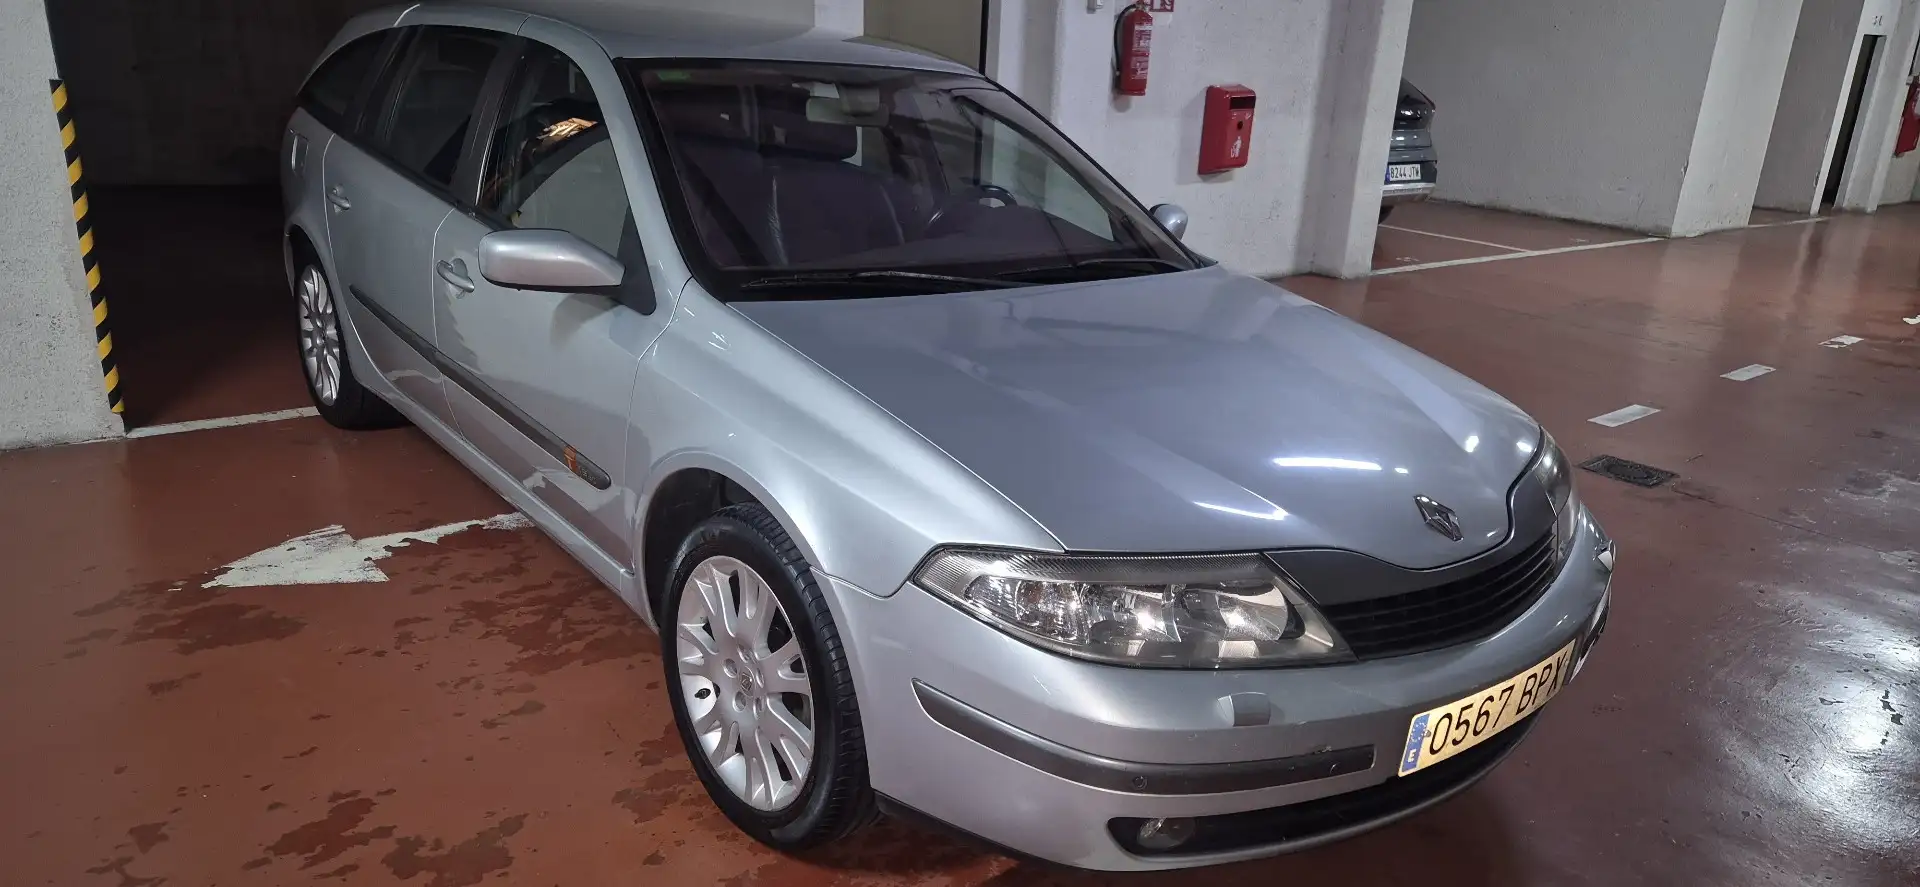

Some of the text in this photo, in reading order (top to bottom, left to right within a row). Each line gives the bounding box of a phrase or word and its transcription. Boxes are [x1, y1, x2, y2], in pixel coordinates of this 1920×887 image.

[1390, 166, 1407, 179] 8244
[1429, 650, 1568, 756] 0567 BPX
[1407, 748, 1417, 763] E
